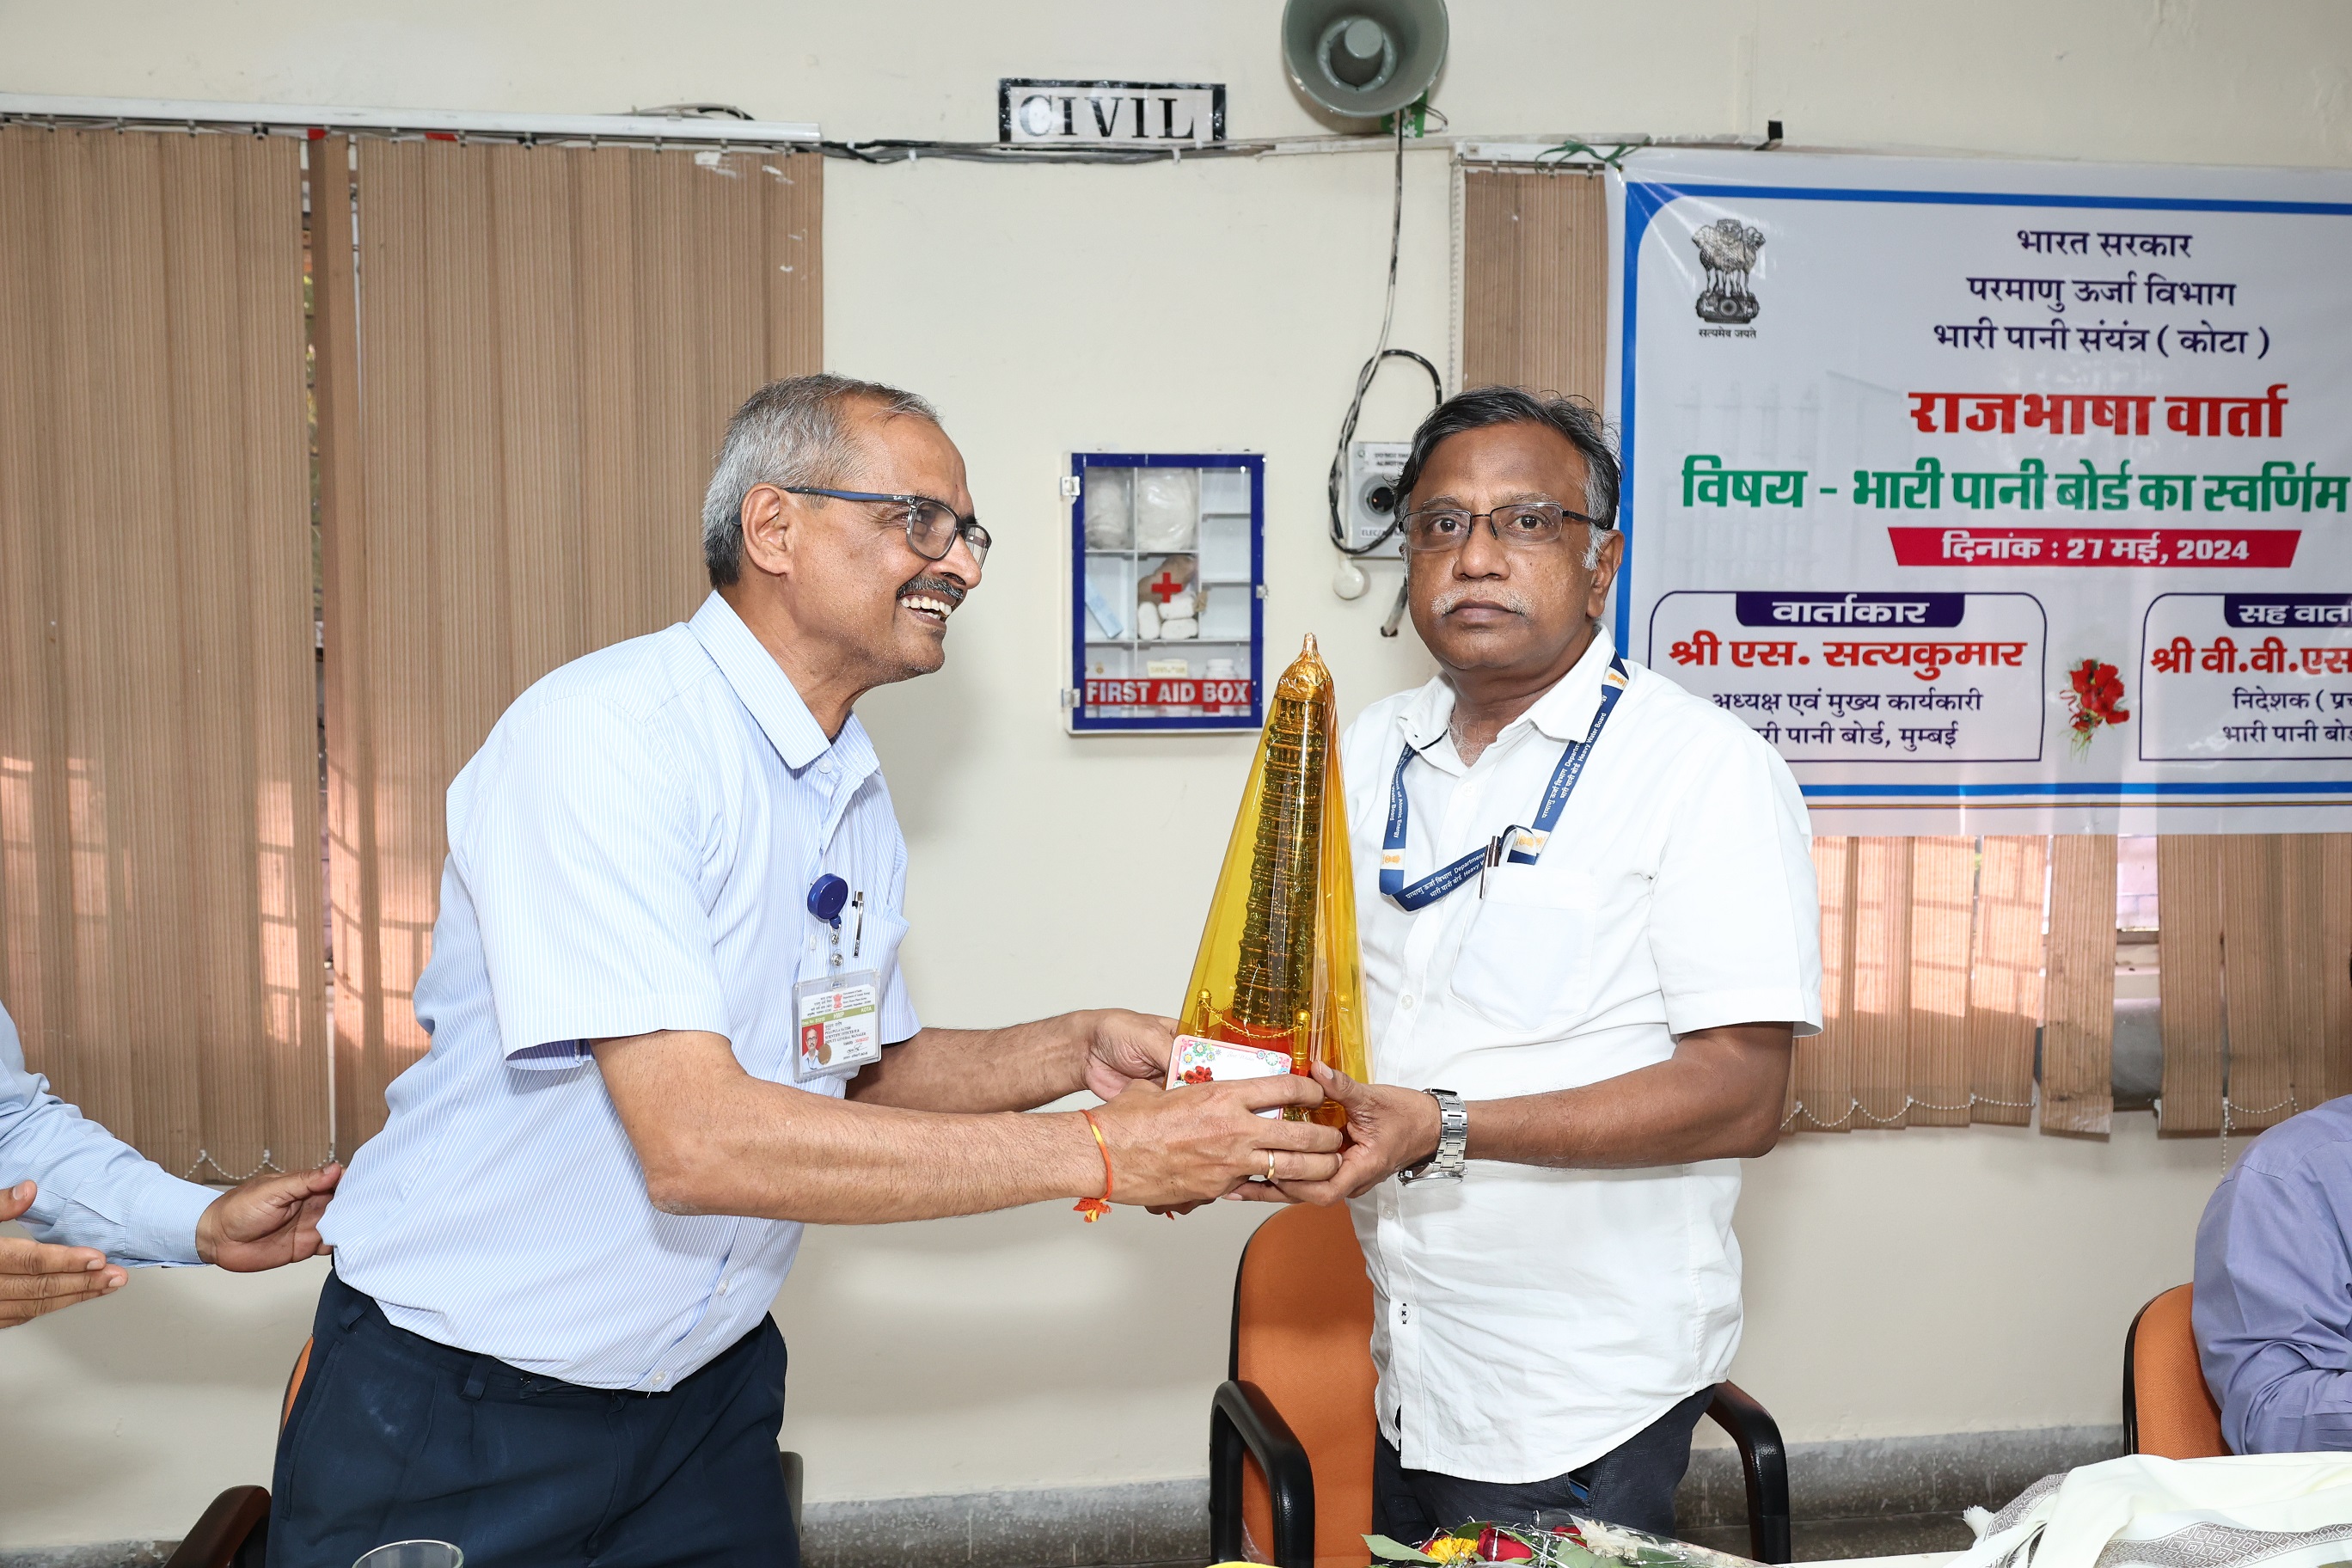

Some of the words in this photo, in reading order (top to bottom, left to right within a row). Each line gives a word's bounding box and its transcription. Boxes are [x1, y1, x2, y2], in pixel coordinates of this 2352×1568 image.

[1020, 95, 1194, 138] CIVIL
[2017, 230, 2090, 255] भारत
[2097, 232, 2192, 257] सरकार
[1966, 276, 2066, 312] परमाणु
[2072, 271, 2137, 303] ऊर्जा
[2144, 273, 2237, 306] विभाग
[1699, 326, 1731, 338] सत्यमेव
[1734, 327, 1757, 338] जयते
[1933, 315, 2000, 349] भारी
[2006, 318, 2070, 350] पानी
[2077, 320, 2150, 352] संयंत्र
[1908, 392, 2156, 436] राजभाषा
[2165, 383, 2288, 438] वार्ता
[1681, 455, 1808, 507] विषय
[1853, 457, 1945, 509] भारी
[1951, 458, 2049, 510] पानी
[2055, 459, 2133, 510] बोर्ड
[2139, 475, 2196, 511] का
[2203, 462, 2351, 512] स्वर्णिम
[1942, 530, 2042, 560] दिनांक
[2067, 539, 2104, 559] 27
[2110, 532, 2168, 564] मई,
[2177, 540, 2249, 560] 2024
[1773, 595, 1930, 623] वार्ताकार
[2239, 604, 2290, 624] सह
[1669, 630, 1722, 665] श्री
[1730, 641, 1810, 667] एस.
[1822, 642, 2027, 681] सत्यकुमार
[2151, 636, 2196, 674] श्री
[1087, 682, 1151, 702] FIRST
[1157, 682, 1196, 702] AID
[1204, 682, 1249, 703] BOX
[1713, 693, 1782, 714] अध्यक्ष
[1787, 688, 1822, 716] एवं
[1827, 695, 1880, 717] मुख्य
[1887, 687, 1983, 710] कार्यकारी
[2233, 686, 2310, 712] निदेशक
[1785, 721, 1835, 744] पानी
[1840, 720, 1890, 748] बोर्ड,
[1899, 720, 1958, 751] मुम्बई
[2223, 720, 2268, 742] भारी
[2272, 720, 2318, 742] पानी
[1554, 769, 1567, 786] विभाग
[1565, 743, 1581, 767] Departm
[1565, 774, 1575, 788] पानी
[1577, 744, 1590, 762] Heavy
[1586, 728, 1599, 744] Water
[1594, 713, 1607, 728] Board
[1393, 818, 1402, 838] Energy
[1406, 886, 1424, 899] परमाणु
[1422, 878, 1436, 890] ऊर्जा
[1435, 871, 1453, 884] विभाग
[1454, 852, 1485, 874] Department
[1430, 886, 1441, 897] भारी
[1441, 880, 1453, 891] पानी
[1453, 873, 1462, 884] बोर्ड
[1463, 863, 1479, 877] Heavy
